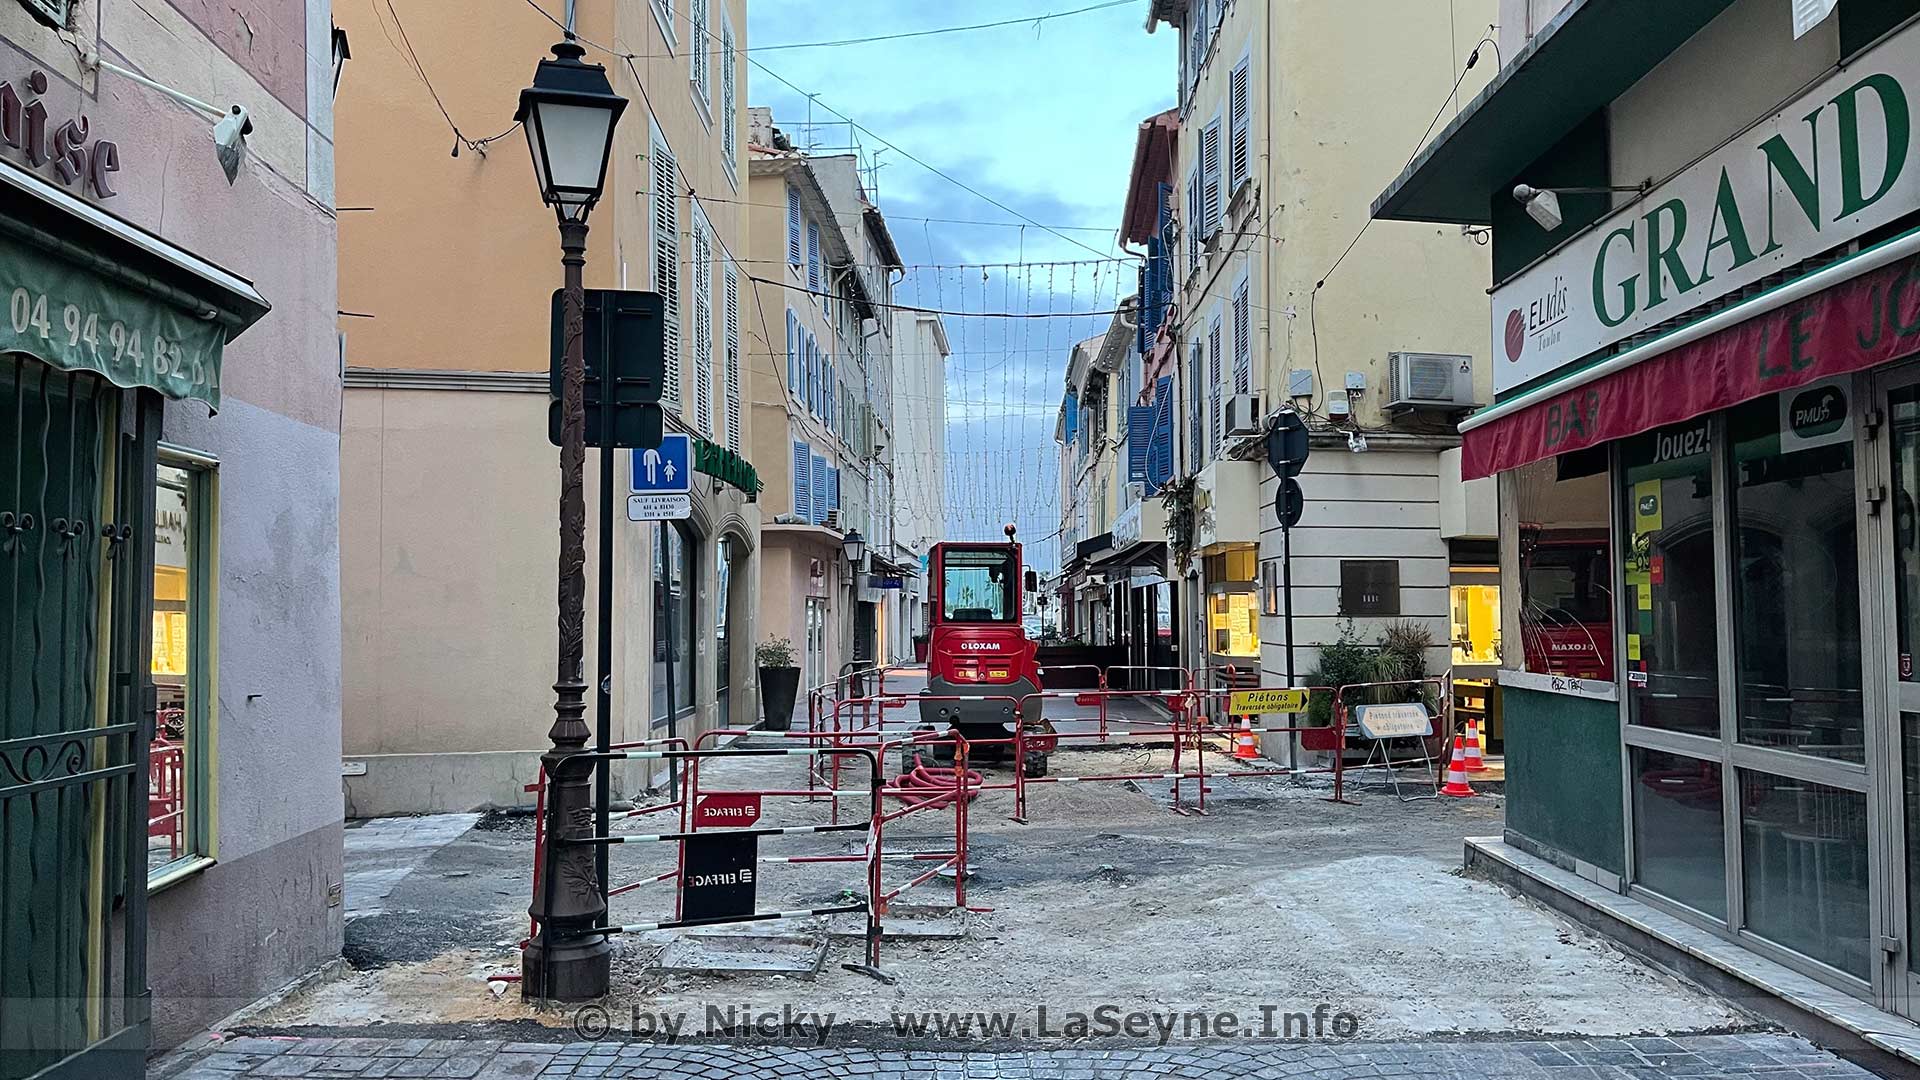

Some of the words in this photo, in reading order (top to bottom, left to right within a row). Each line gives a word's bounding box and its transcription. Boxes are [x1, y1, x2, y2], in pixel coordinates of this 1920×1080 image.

[1592, 73, 1911, 328] GRAND
[11, 286, 51, 339] 04
[63, 303, 100, 354] 94
[109, 320, 145, 369] 94
[153, 335, 185, 380] 82
[1545, 390, 1601, 449] BAR
[1758, 306, 1816, 378] LE
[1795, 405, 1822, 428] PMU
[1652, 419, 1711, 464] Jouez!
[1236, 702, 1266, 712] Traversée
[1266, 702, 1299, 712] obligatoire
[1247, 691, 1289, 703] Piétons
